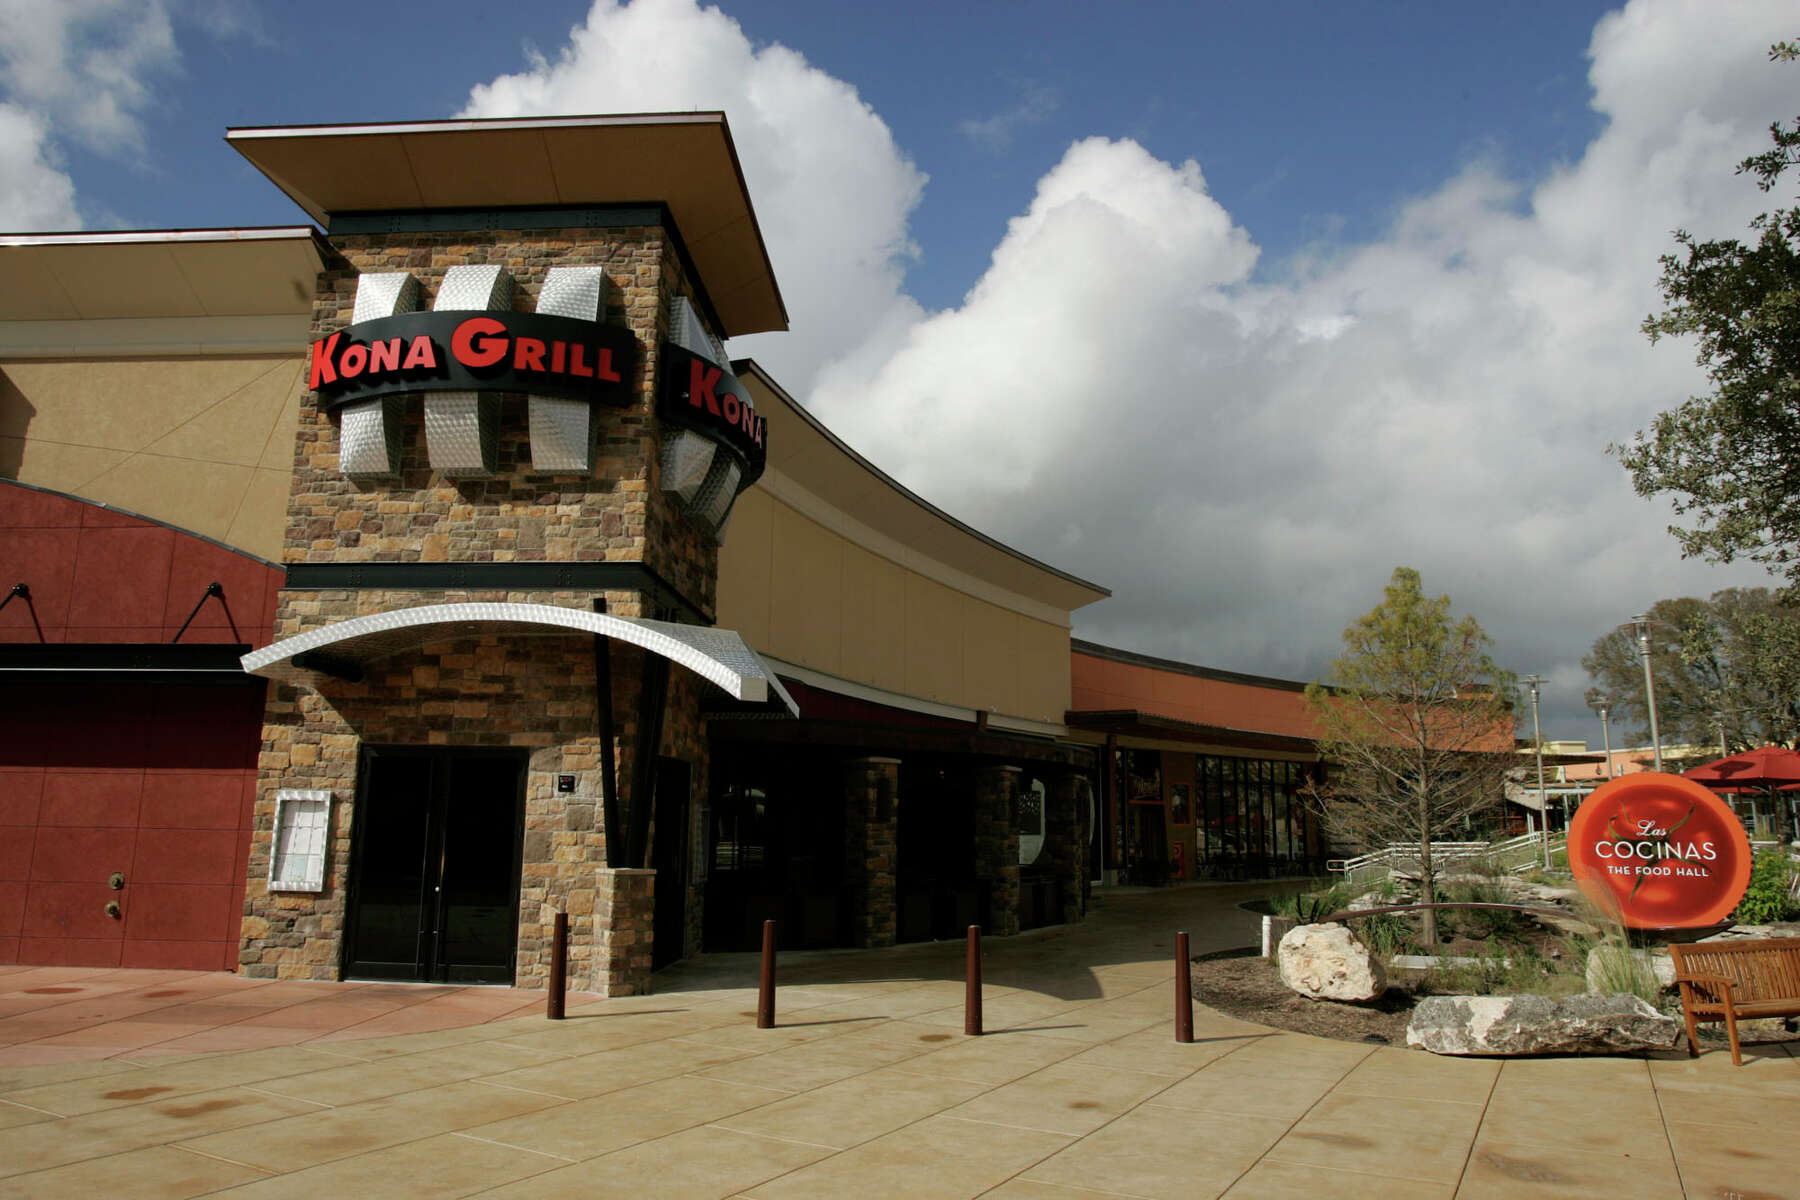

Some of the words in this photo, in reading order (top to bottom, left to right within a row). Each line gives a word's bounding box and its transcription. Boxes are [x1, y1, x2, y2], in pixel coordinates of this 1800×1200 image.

[310, 332, 437, 390] KONA
[451, 316, 621, 383] GRILL
[1636, 820, 1667, 836] Las
[1595, 841, 1717, 860] COCINAS
[1607, 865, 1631, 875] THE
[1635, 866, 1672, 876] FOOD
[1676, 867, 1709, 877] HALL
